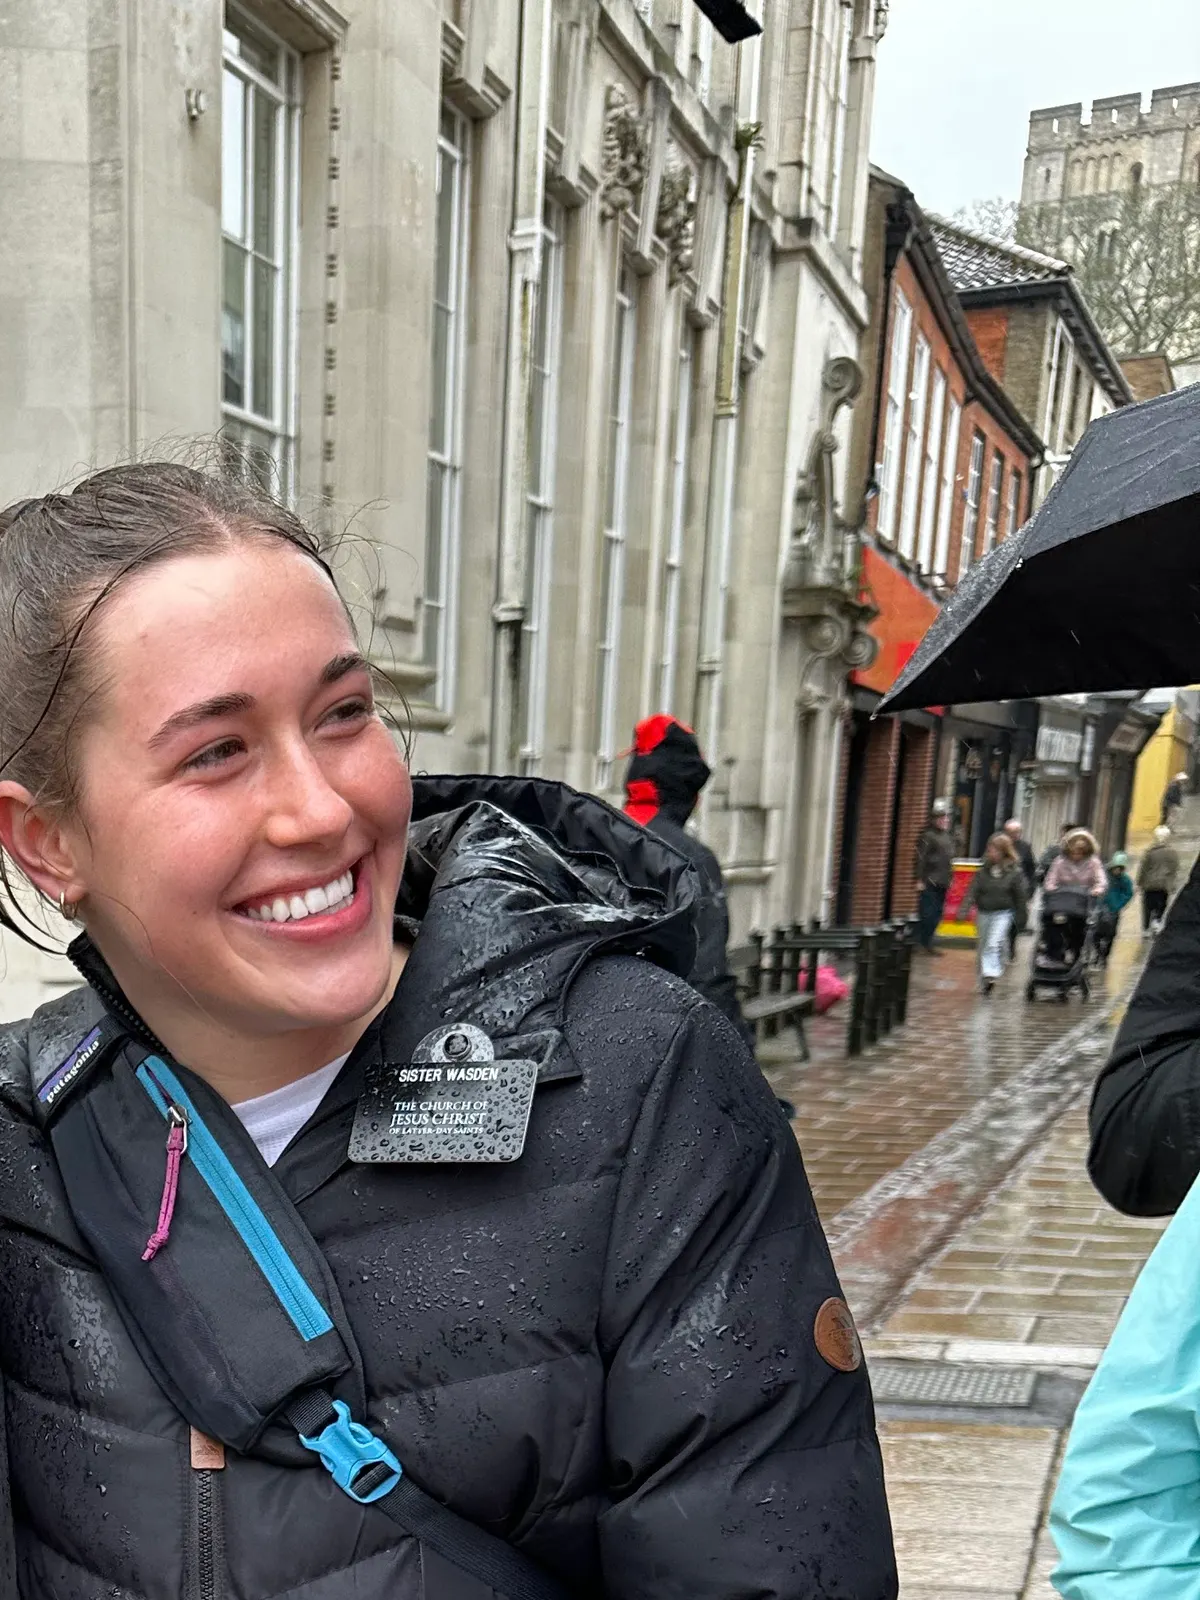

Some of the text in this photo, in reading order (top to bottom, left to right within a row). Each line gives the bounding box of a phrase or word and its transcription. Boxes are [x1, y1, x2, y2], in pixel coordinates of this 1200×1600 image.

[46, 1040, 99, 1103] patagonia
[399, 1067, 499, 1083] SISTER WASDEN
[394, 1101, 488, 1111] THE CHURCH OF
[390, 1112, 486, 1127] JESUS CHRIST
